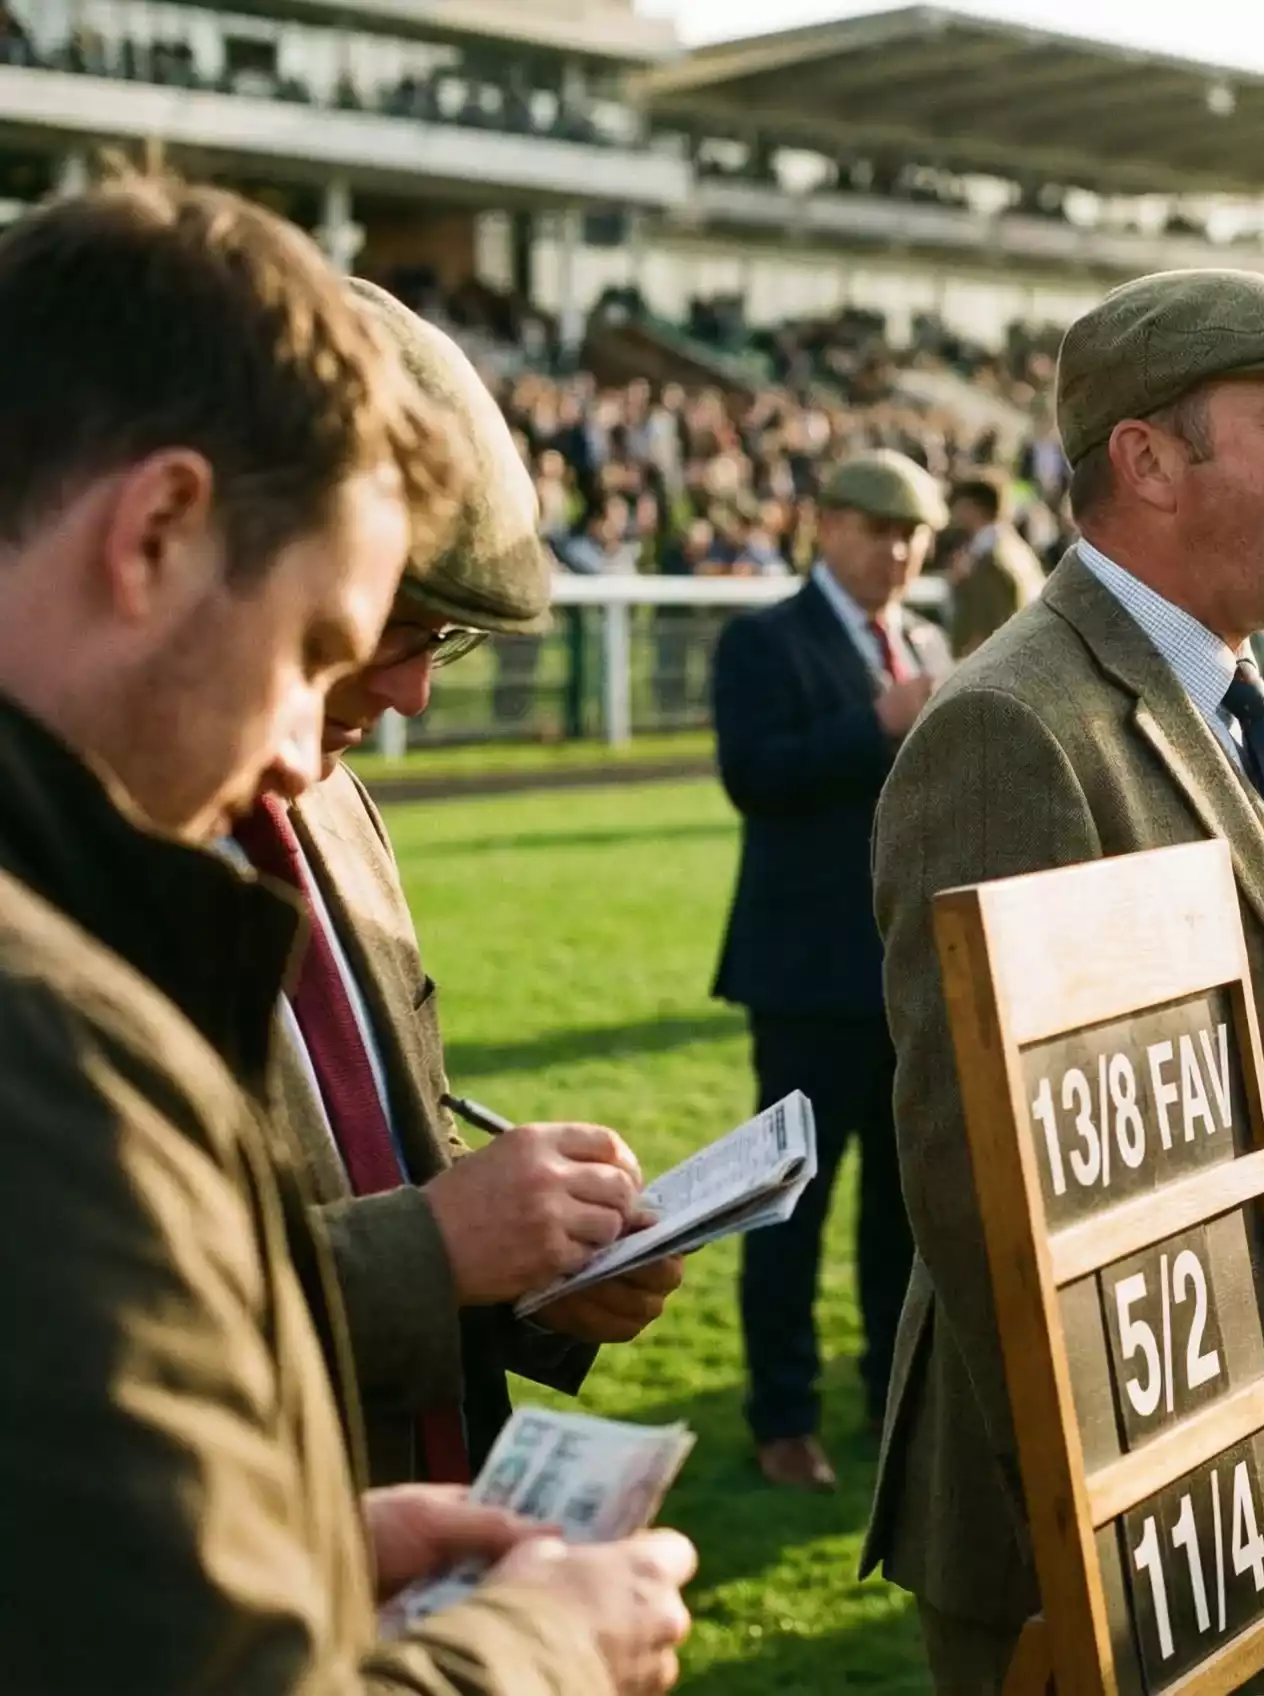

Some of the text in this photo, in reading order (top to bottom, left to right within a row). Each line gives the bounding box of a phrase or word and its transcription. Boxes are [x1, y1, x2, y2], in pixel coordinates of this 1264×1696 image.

[1032, 1023, 1232, 1196] 13/8 FAV
[1114, 1249, 1221, 1416] 5/2
